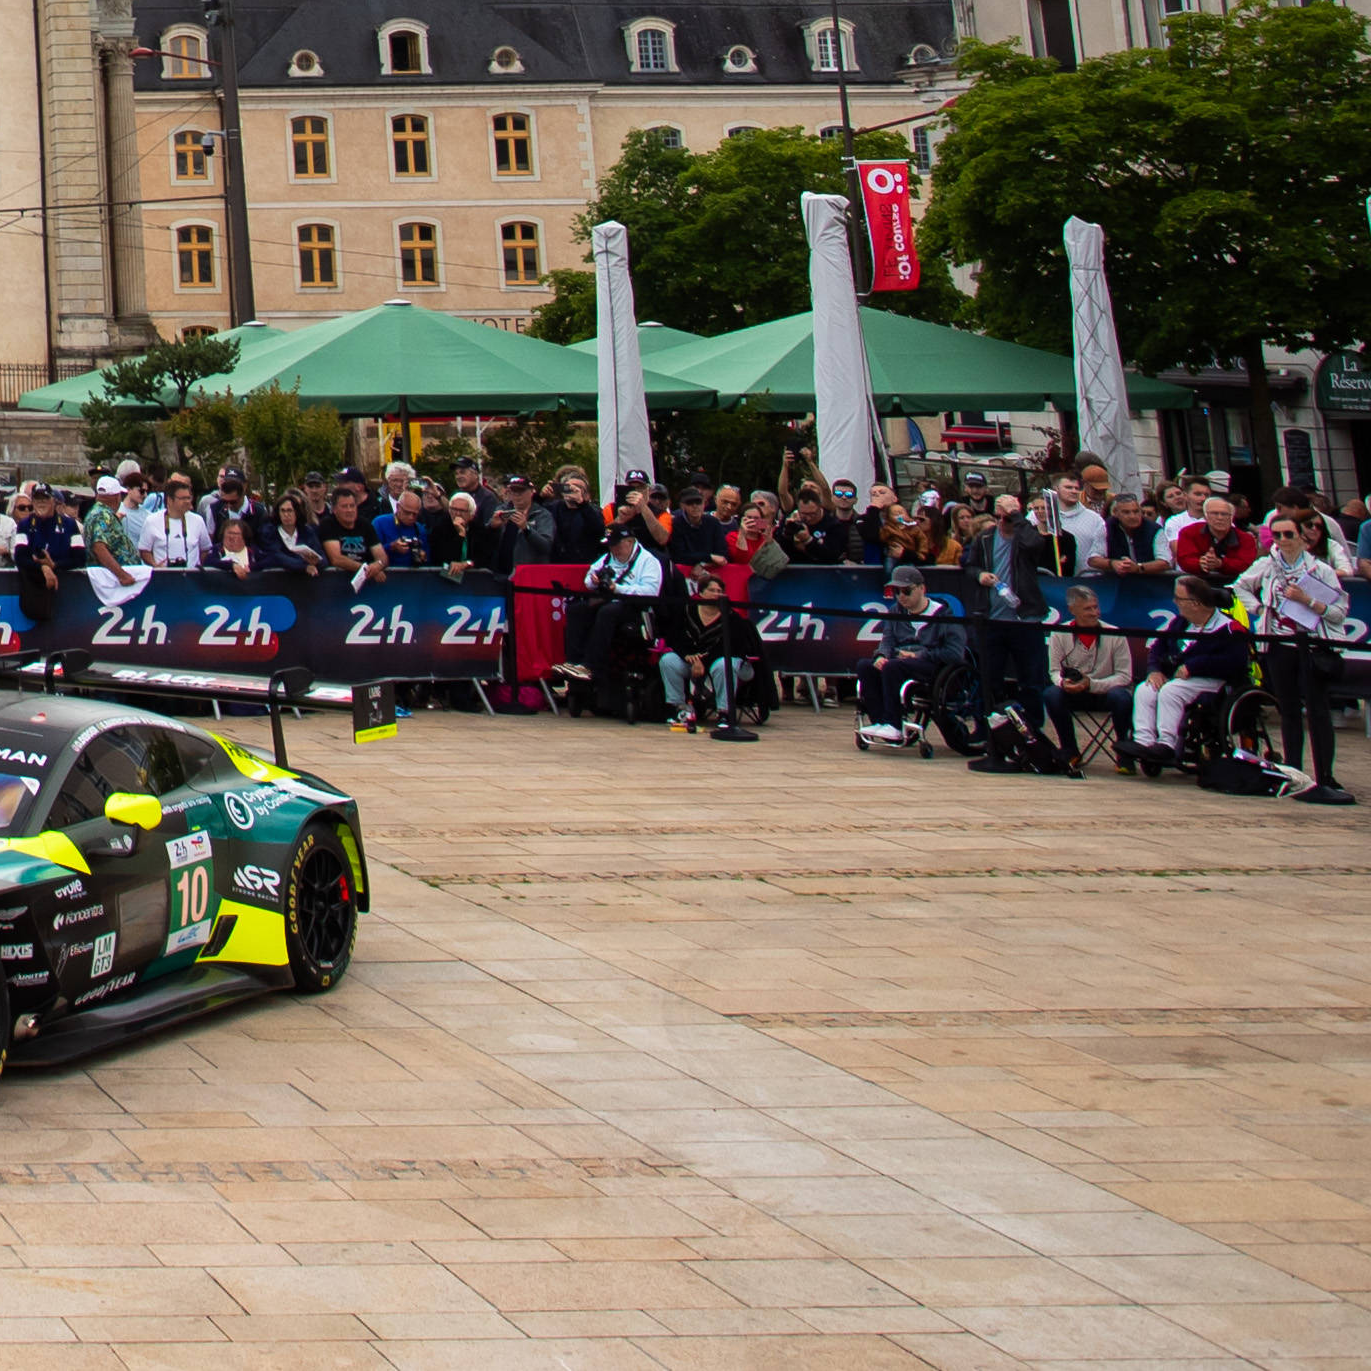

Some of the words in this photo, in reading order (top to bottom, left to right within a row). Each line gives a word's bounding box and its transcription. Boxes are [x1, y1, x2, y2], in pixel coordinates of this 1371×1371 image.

[1342, 356, 1358, 371] La
[111, 669, 216, 687] BLACK
[177, 866, 208, 927] 10
[98, 936, 113, 955] LM
[94, 955, 112, 975] GT3
